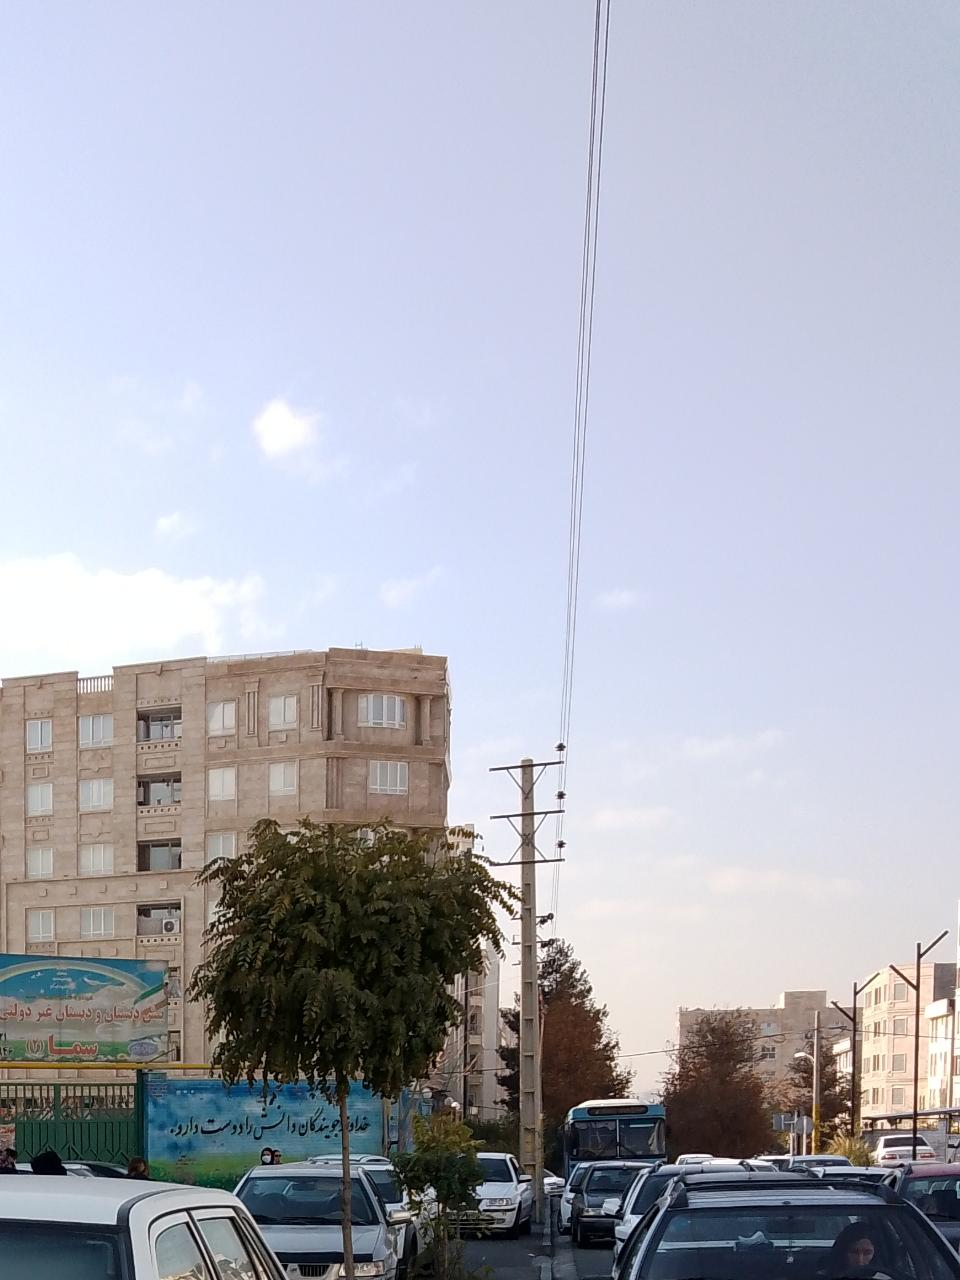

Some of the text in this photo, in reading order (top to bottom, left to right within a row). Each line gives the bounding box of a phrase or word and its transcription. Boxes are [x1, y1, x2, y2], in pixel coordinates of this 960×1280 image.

[55, 1004, 92, 1022] دبستان
[95, 1009, 102, 1024] و
[105, 1005, 140, 1023] دبستان
[48, 1034, 98, 1056] سما
[200, 1118, 244, 1136] دوست
[246, 1114, 253, 1136] را
